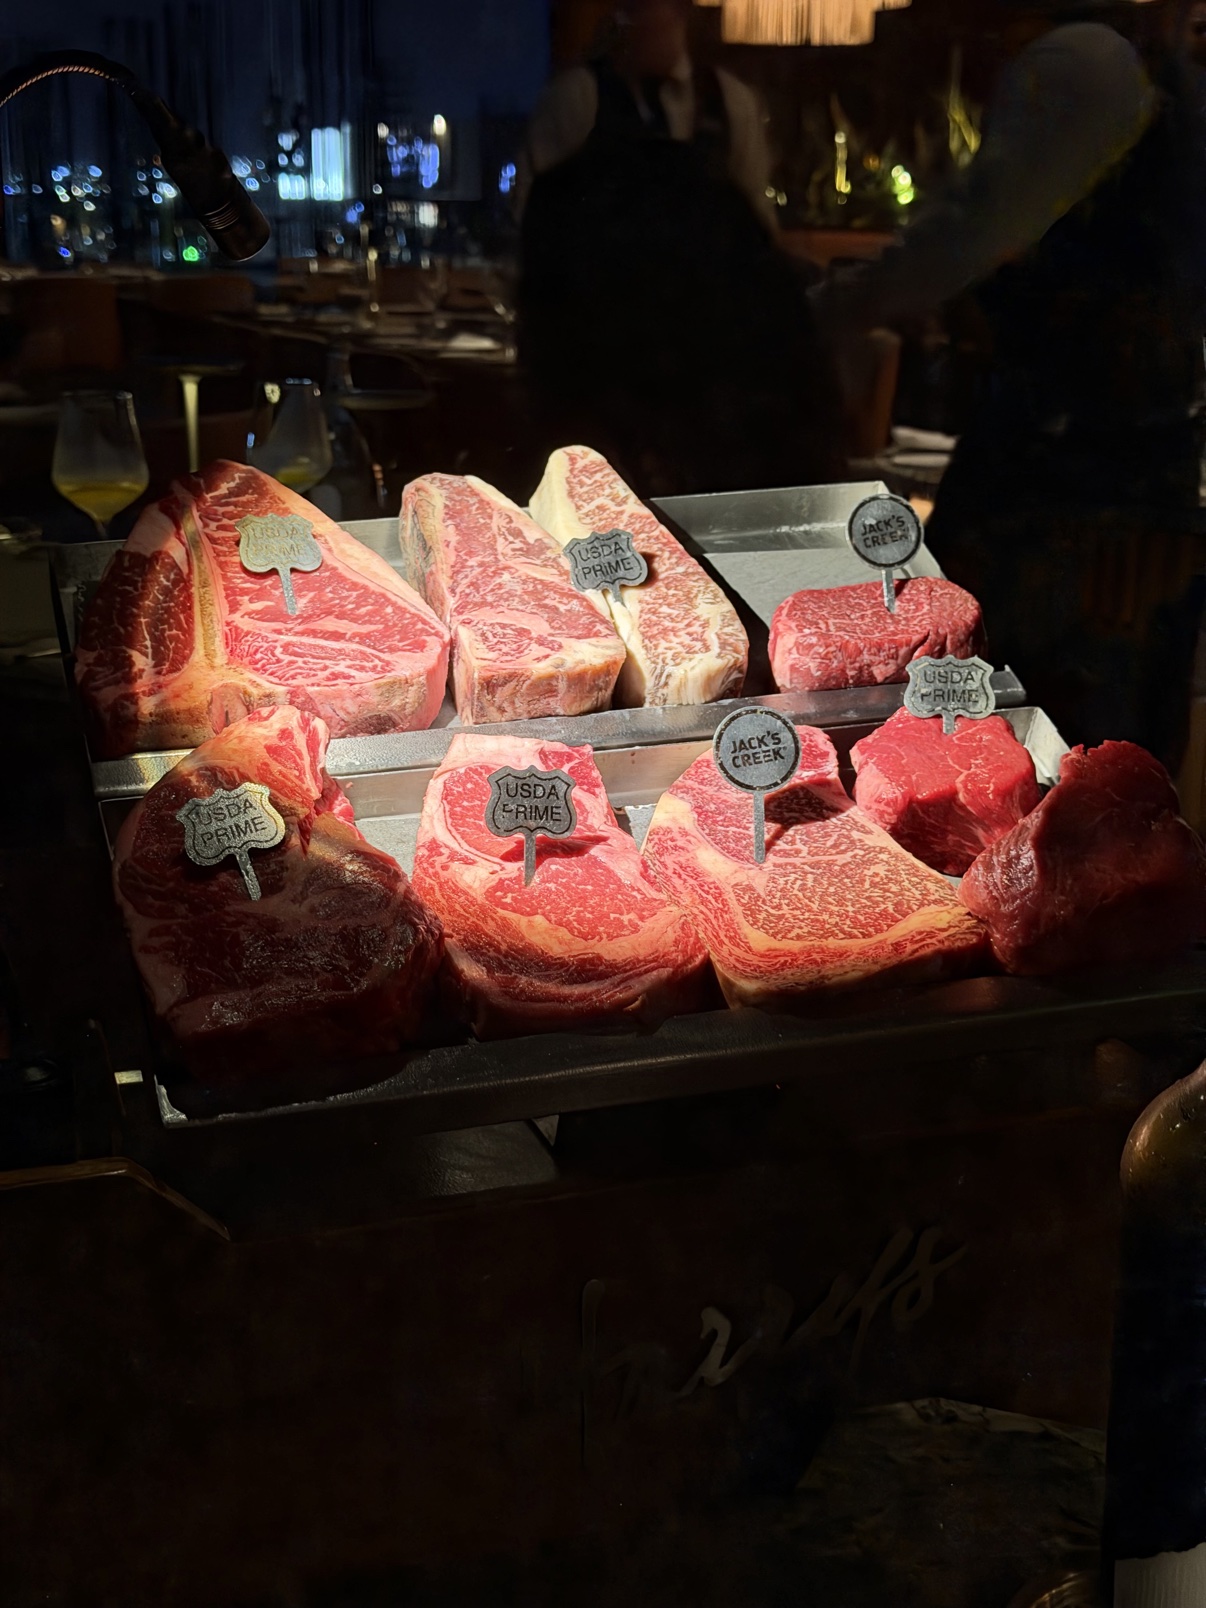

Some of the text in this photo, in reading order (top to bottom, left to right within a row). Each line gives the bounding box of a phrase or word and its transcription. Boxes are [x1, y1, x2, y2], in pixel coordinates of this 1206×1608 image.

[861, 515, 905, 536] JACK'S
[578, 541, 625, 562] USDA
[582, 557, 634, 580] PRIME
[923, 670, 976, 684] USDA
[920, 688, 979, 703] PRIME
[731, 731, 782, 754] JACK'S
[731, 747, 785, 768] CREEK
[506, 782, 560, 800] USDA
[197, 798, 257, 826] USDA
[200, 815, 267, 847] PRIME
